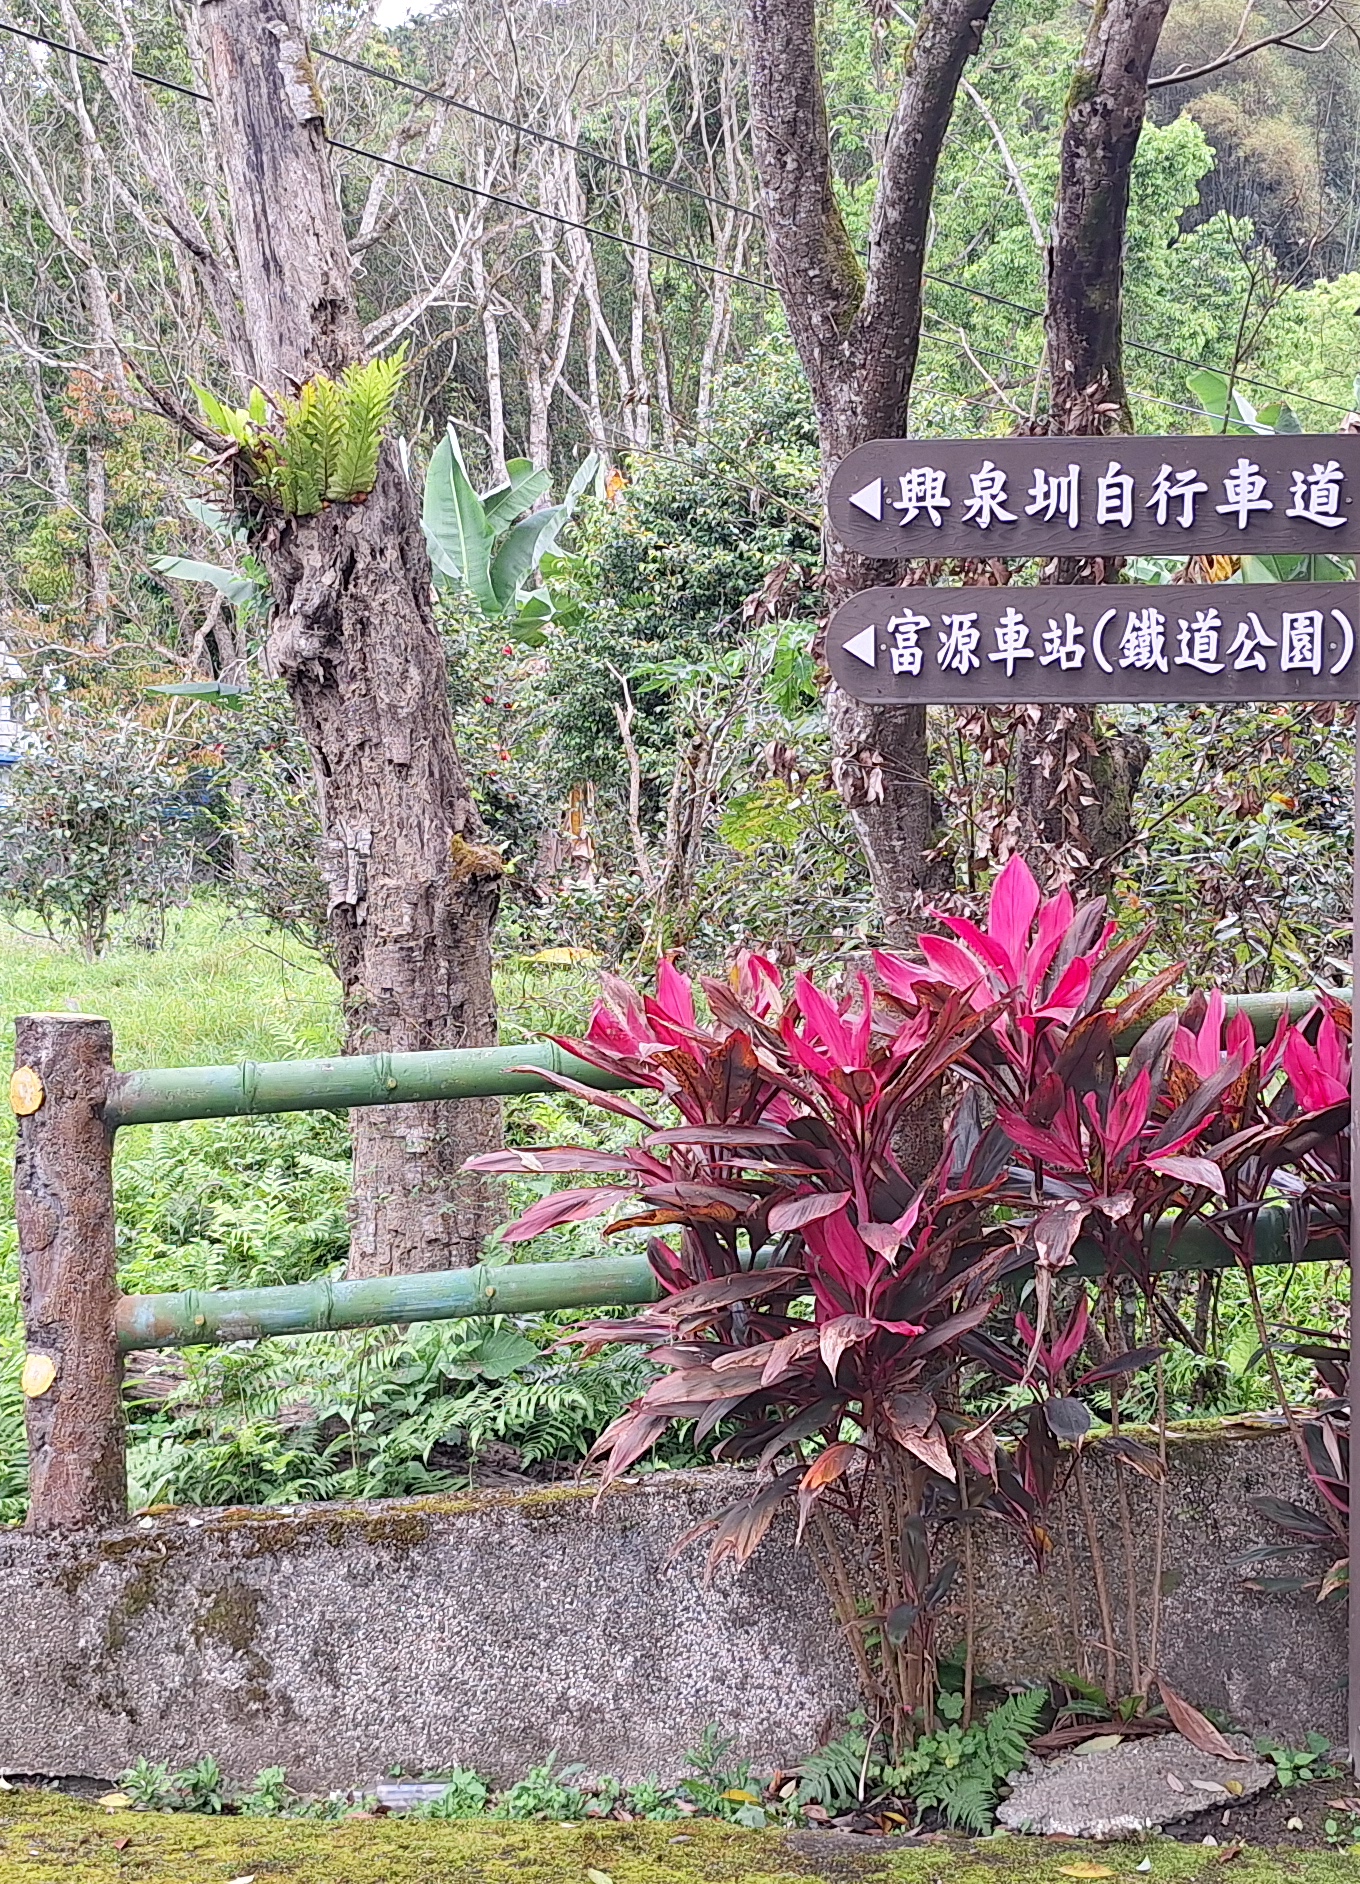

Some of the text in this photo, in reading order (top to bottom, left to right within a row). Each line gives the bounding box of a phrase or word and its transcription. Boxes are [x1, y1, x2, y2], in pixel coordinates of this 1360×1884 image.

[892, 458, 1348, 530] 興泉圳自行車道
[886, 606, 1355, 677] 富源車站(鐵道公園)
